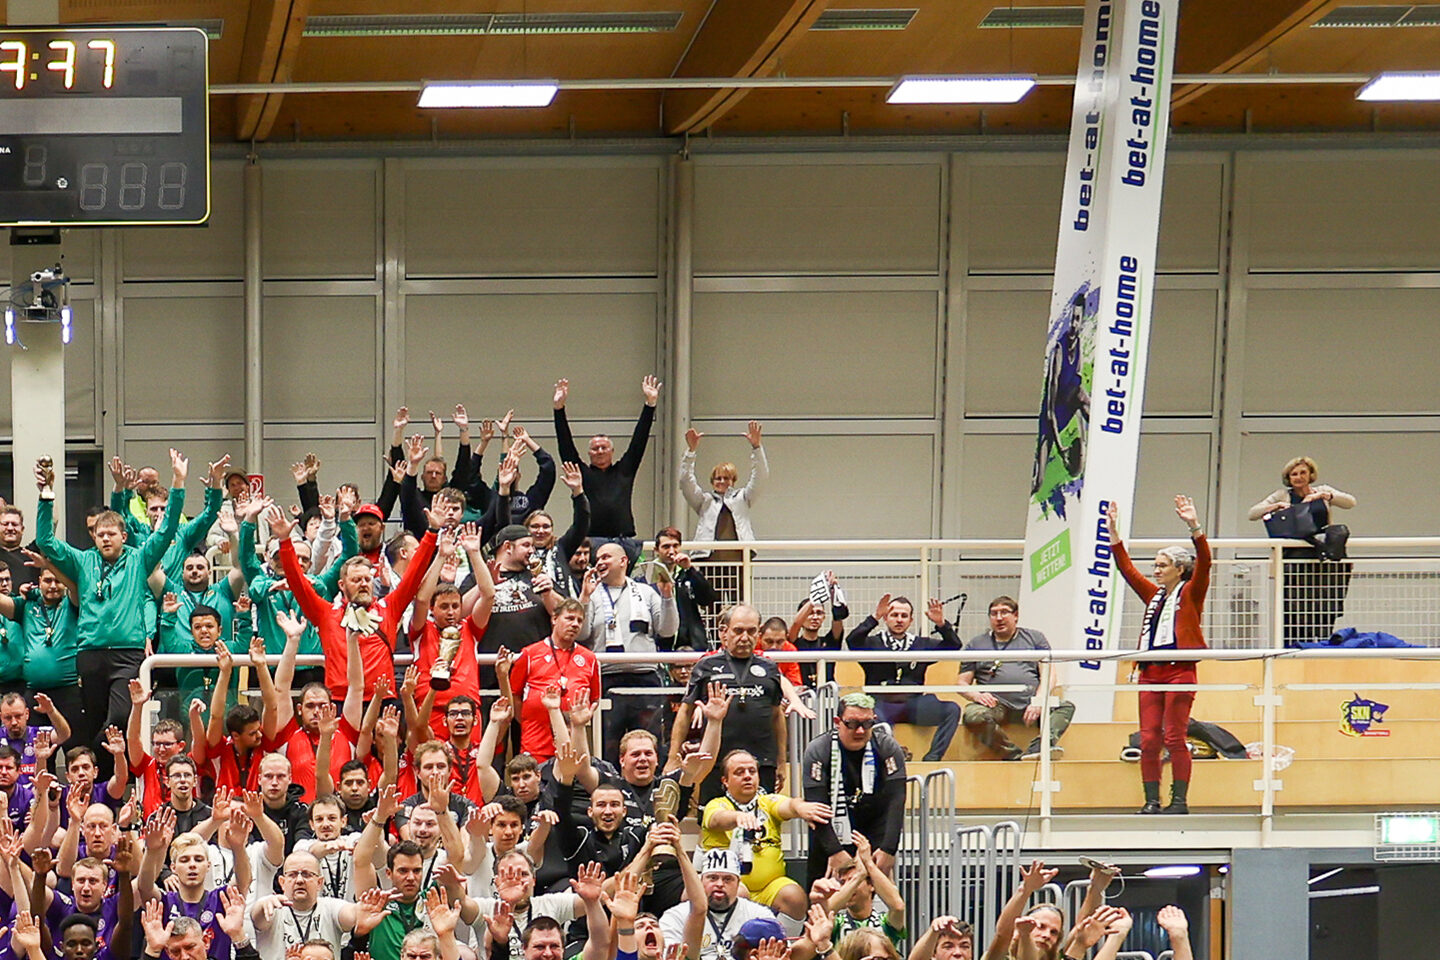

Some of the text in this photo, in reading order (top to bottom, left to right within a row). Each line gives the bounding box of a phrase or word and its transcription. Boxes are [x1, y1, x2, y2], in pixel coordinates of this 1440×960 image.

[1074, 0, 1111, 231] bet-at-hom
[1122, 0, 1160, 187] bet-at-home
[1100, 255, 1138, 435] bet-at-home
[1039, 539, 1061, 566] JETZT
